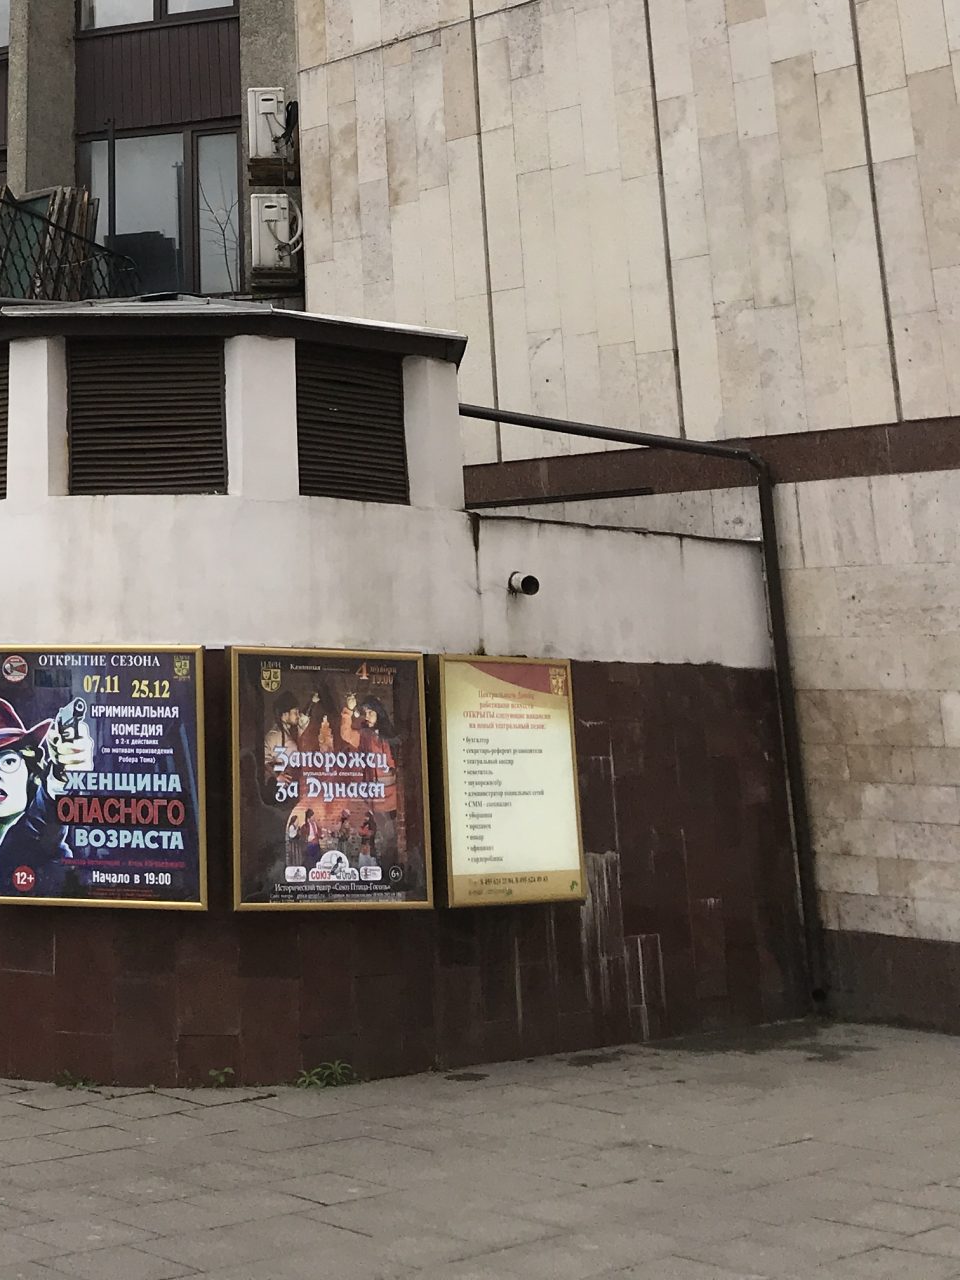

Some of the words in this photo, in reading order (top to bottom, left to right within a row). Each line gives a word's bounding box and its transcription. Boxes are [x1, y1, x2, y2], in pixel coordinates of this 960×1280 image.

[38, 655, 107, 667] ОТКРЫТИЕ
[110, 655, 161, 667] СЕЗОНА
[356, 662, 369, 680] 4
[83, 675, 120, 693] 07.11
[131, 680, 171, 698] 25.12
[91, 705, 179, 718] КРИМИНАЛЬНАЯ
[463, 711, 495, 719] ОТКРЫТЫ
[111, 723, 163, 737] КОМЕДИЯ
[495, 722, 529, 730] театральный
[131, 738, 159, 746] действиях
[101, 747, 111, 756] (по
[112, 747, 135, 755] мотивам
[135, 747, 174, 756] произведений
[118, 756, 139, 764] Робера
[140, 756, 156, 764] Тома)
[273, 746, 390, 772] Запорожец
[64, 772, 183, 794] ЖЕНЩИНА
[275, 780, 299, 802] за
[306, 777, 385, 802] Дунаем
[57, 797, 185, 825] ОПАСНОГО
[75, 829, 184, 850] ВОЗРАСТА
[15, 872, 34, 885] 12+
[92, 870, 130, 884] Начало
[134, 874, 140, 884] в
[144, 872, 171, 885] 19:00
[311, 870, 331, 880] СОЮЗ
[275, 883, 314, 893] Исторический
